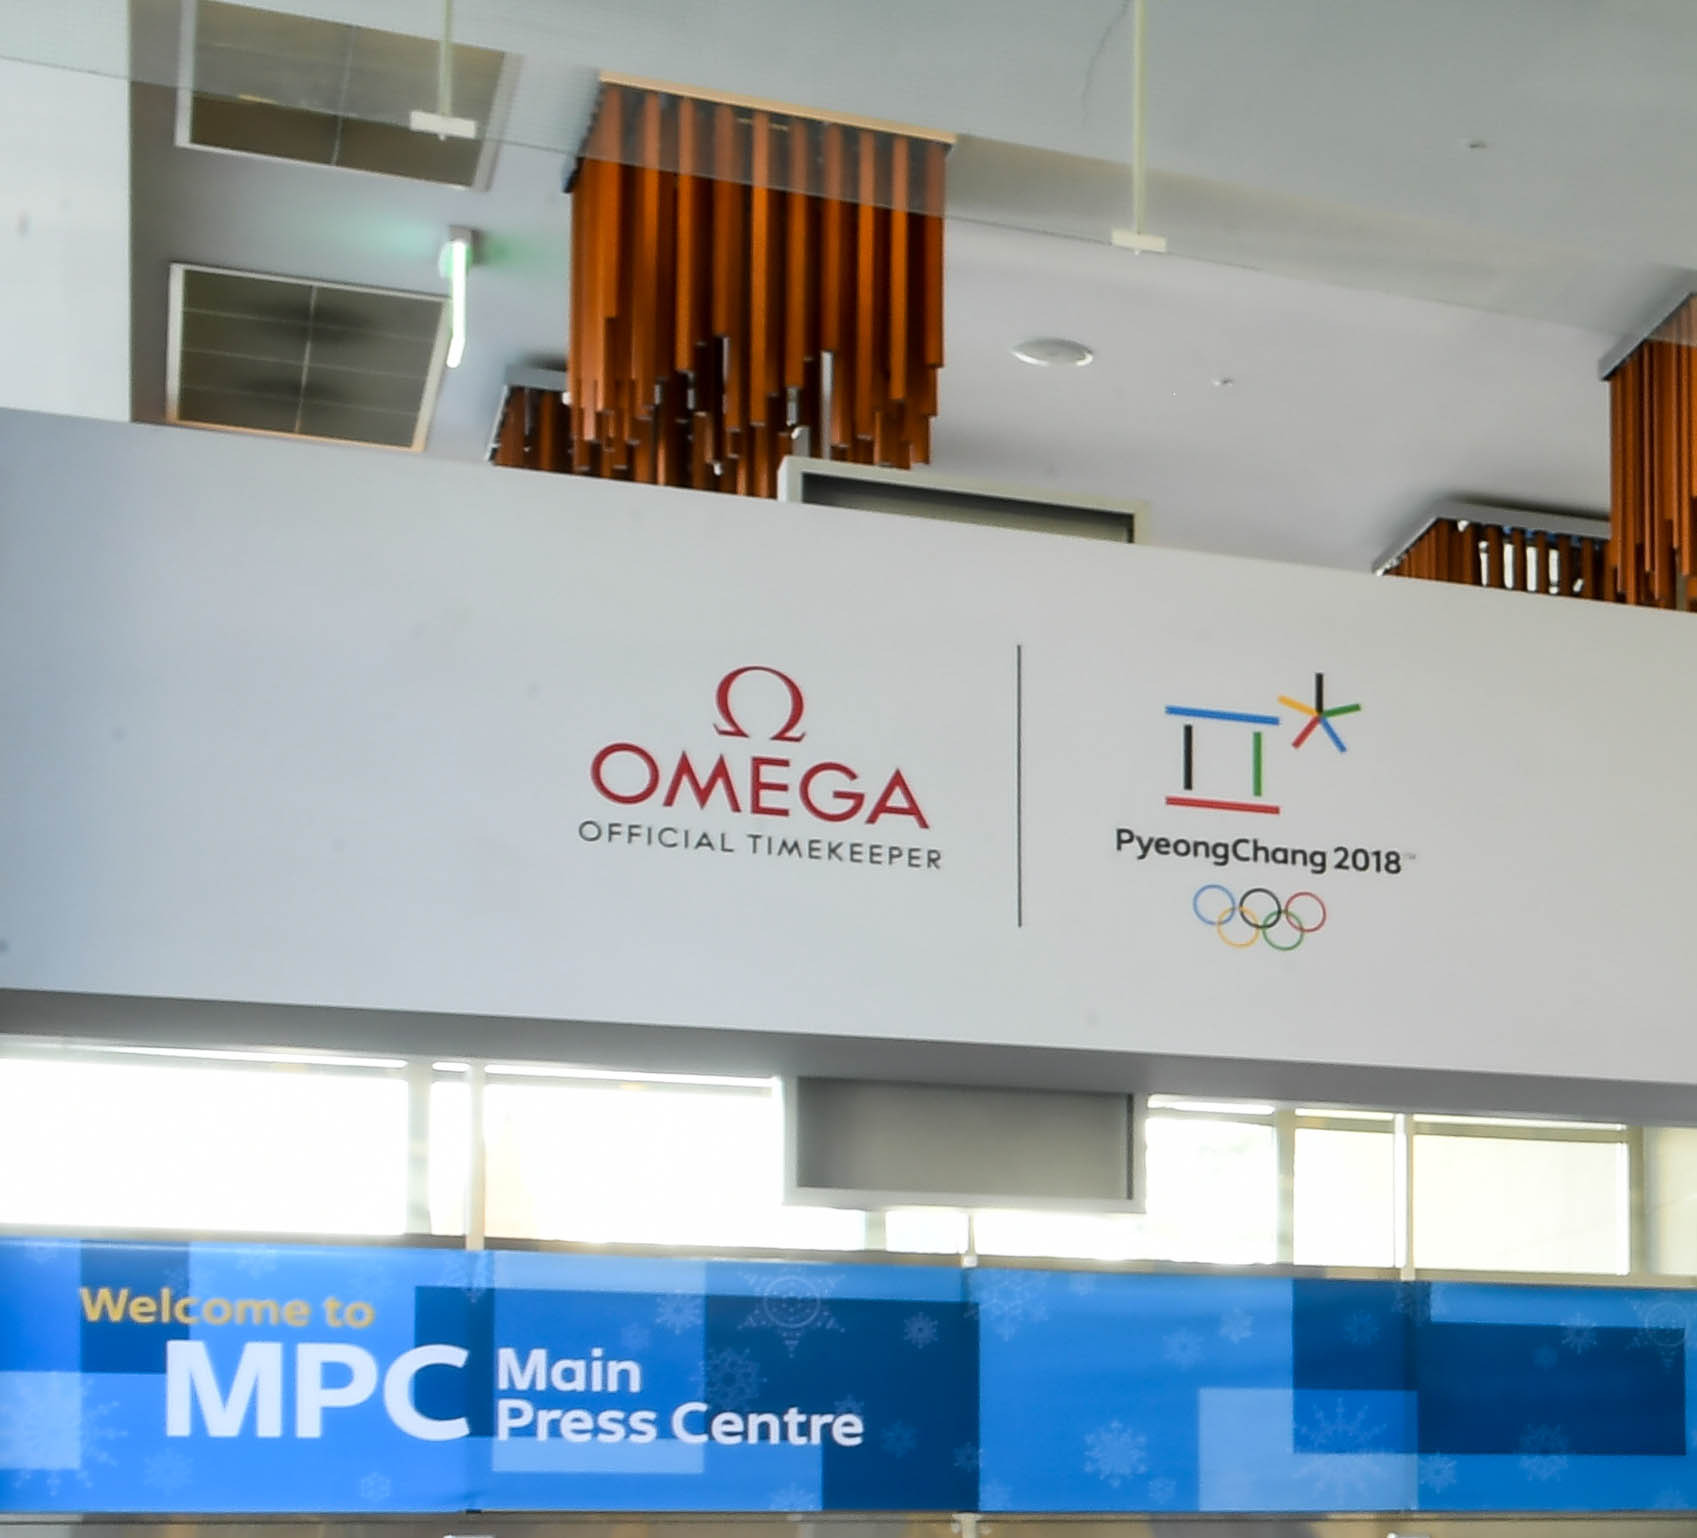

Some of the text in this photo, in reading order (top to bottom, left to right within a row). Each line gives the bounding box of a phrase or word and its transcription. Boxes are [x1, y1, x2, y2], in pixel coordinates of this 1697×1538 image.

[590, 742, 930, 830] OMEGA
[578, 820, 943, 870] OFFICIAL TIMEKEEPER
[1115, 827, 1403, 875] PyeongChang 2018
[80, 1287, 375, 1329] Welcome to
[165, 1339, 470, 1442] MPC
[497, 1347, 642, 1393] Main
[497, 1398, 864, 1446] Press Centre
